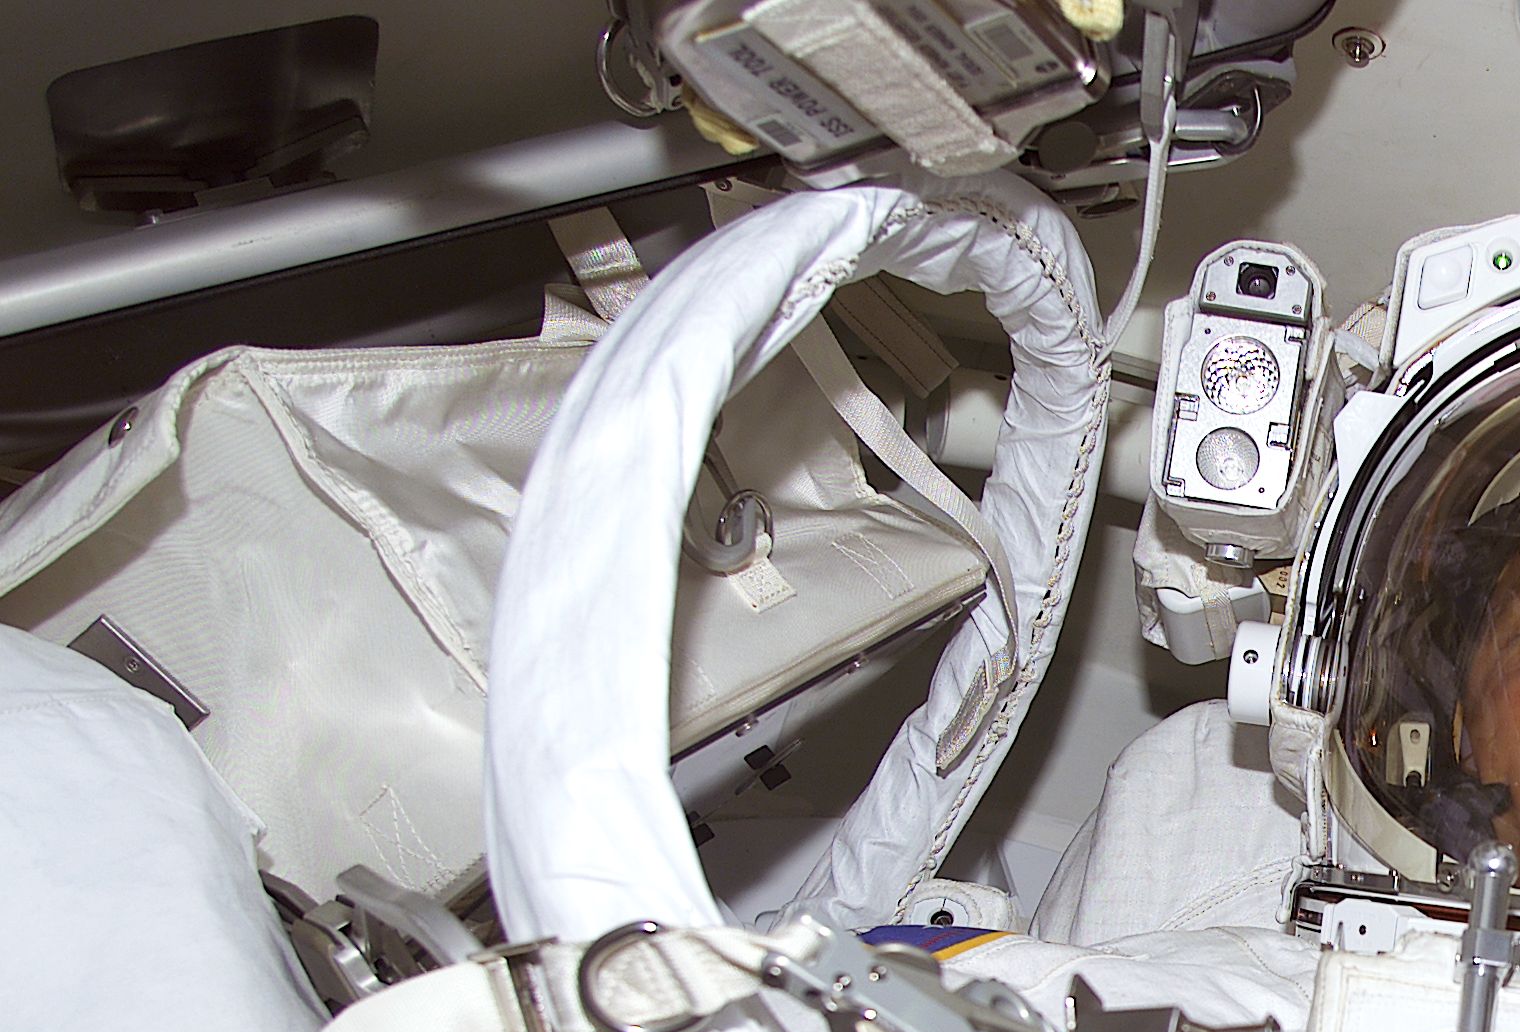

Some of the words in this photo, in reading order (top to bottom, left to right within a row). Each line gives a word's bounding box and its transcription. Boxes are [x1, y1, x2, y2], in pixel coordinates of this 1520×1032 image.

[728, 42, 774, 77] TOOL
[769, 76, 828, 117] POWER
[820, 115, 855, 137] ISS
[1276, 567, 1289, 589] 002
